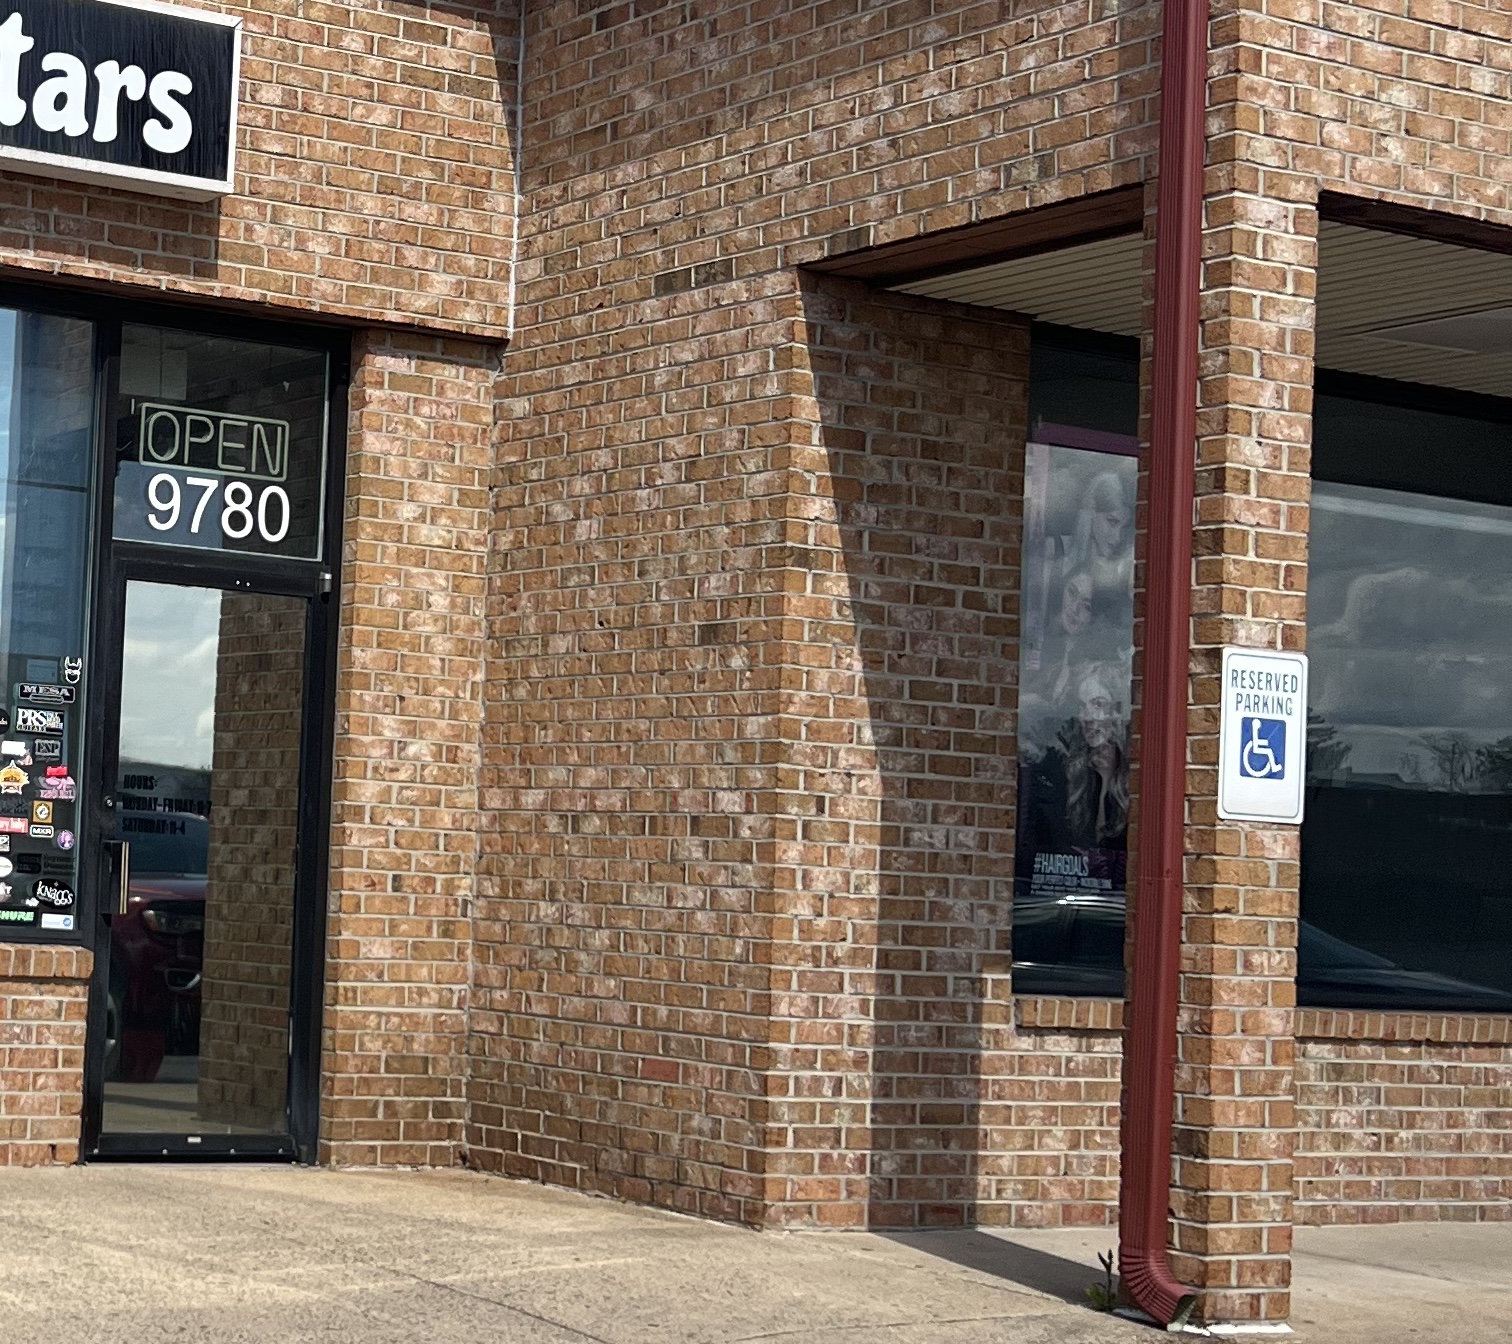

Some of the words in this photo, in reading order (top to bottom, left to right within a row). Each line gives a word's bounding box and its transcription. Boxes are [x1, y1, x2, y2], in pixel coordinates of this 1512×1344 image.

[147, 410, 283, 476] OPEN
[147, 473, 291, 544] 9780
[22, 685, 71, 697] MESA
[1231, 668, 1298, 694] RESERVED
[1235, 692, 1294, 716] PARKING
[17, 708, 48, 726] PRS
[32, 827, 52, 835] MXR
[1033, 852, 1089, 876] #HAIRGOALS
